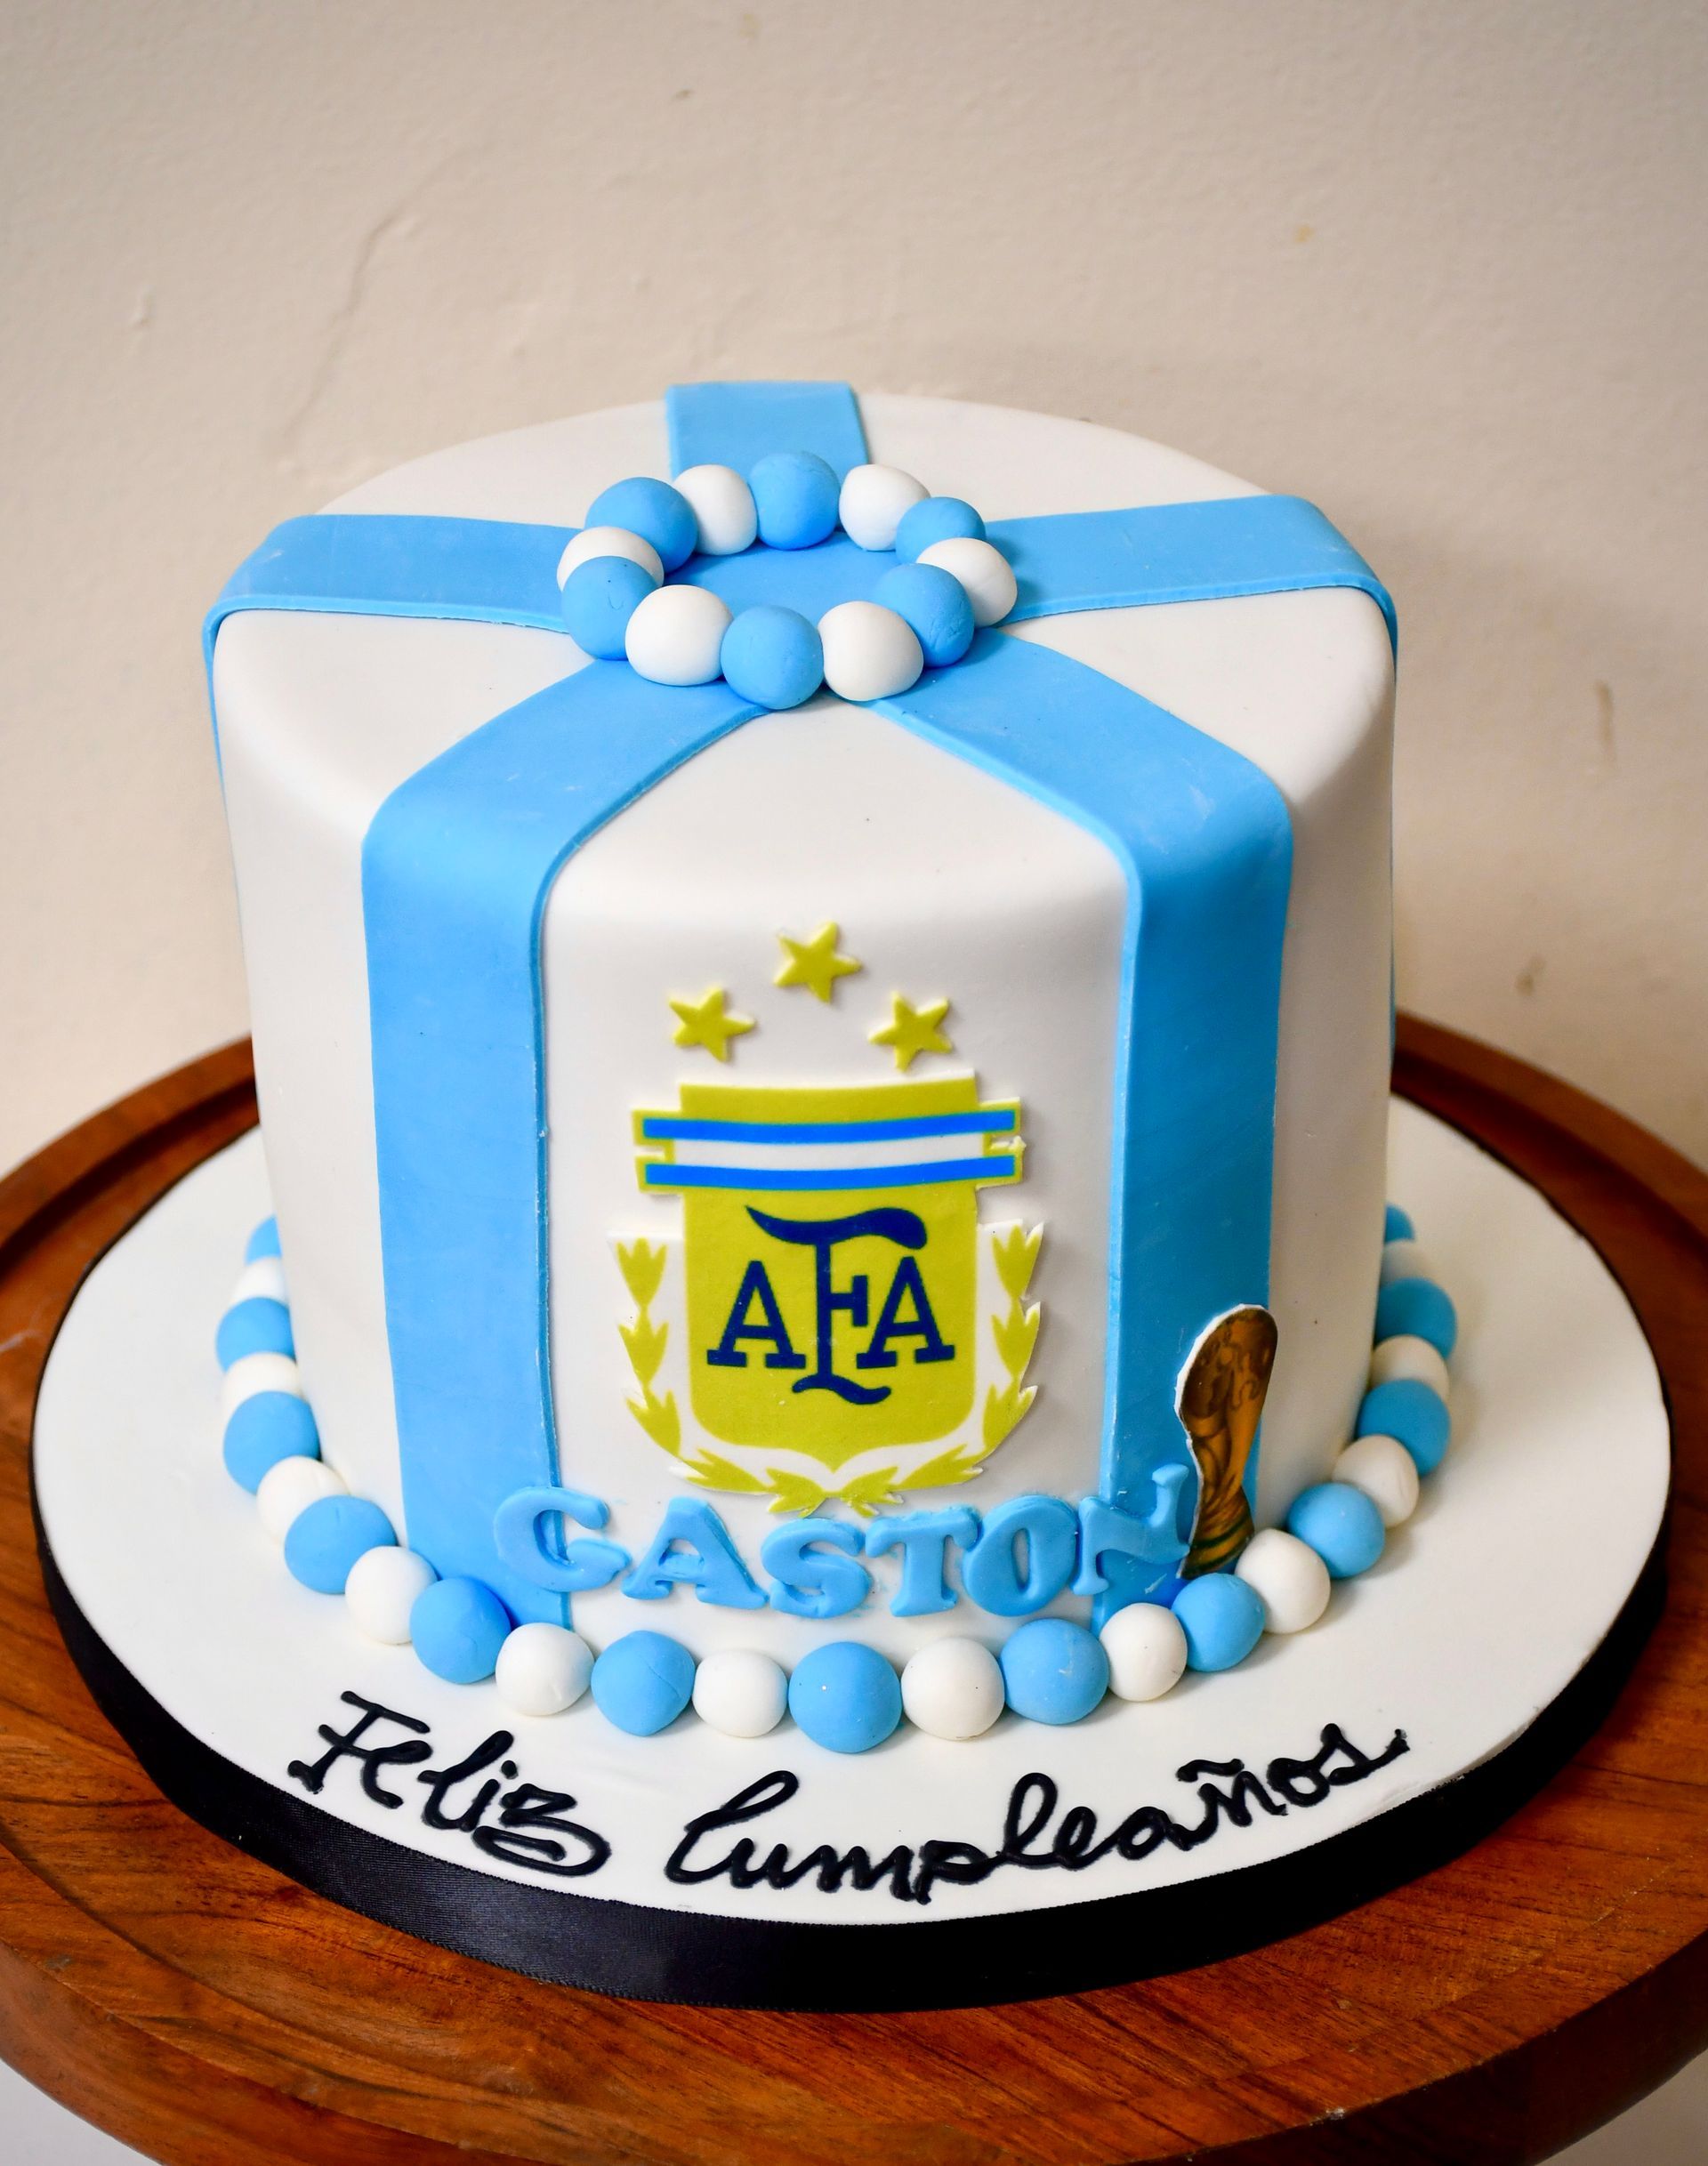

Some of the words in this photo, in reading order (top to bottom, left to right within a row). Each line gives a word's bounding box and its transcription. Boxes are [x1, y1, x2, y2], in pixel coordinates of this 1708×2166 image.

[706, 1205, 955, 1405] AFA
[493, 1463, 1191, 1619] GASTON
[286, 1690, 612, 1877] Feliz
